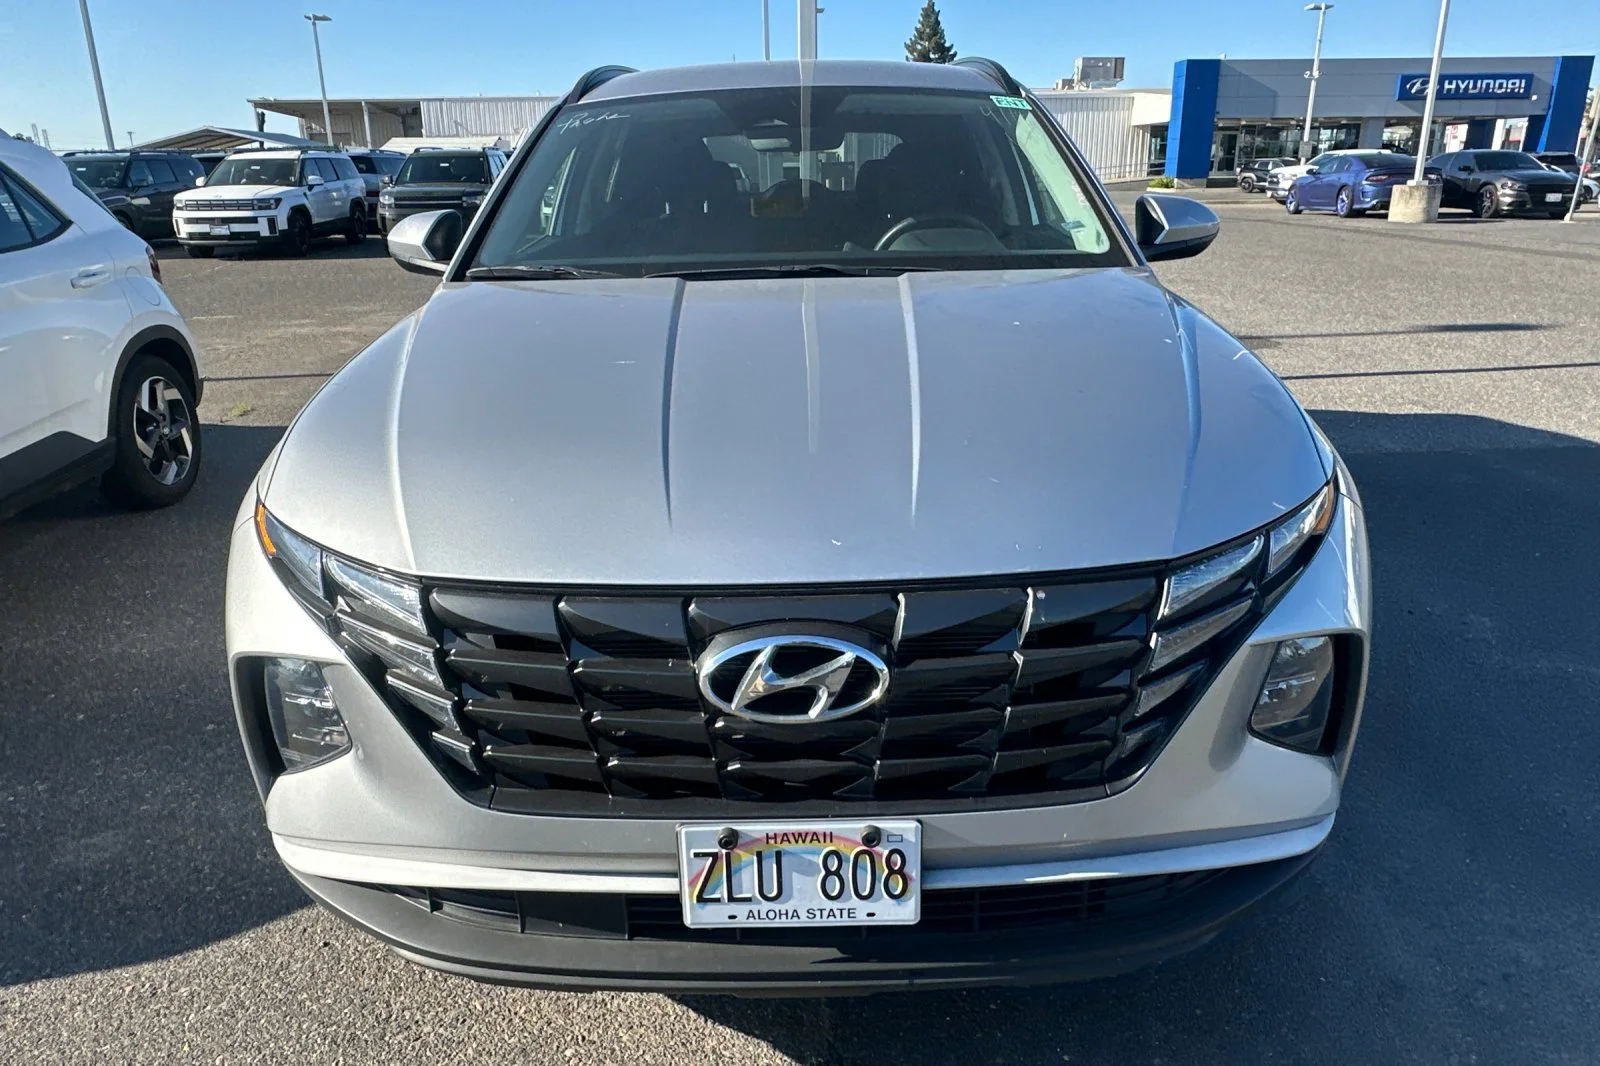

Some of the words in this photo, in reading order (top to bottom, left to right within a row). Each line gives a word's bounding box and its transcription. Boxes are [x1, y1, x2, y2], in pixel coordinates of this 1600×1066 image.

[1442, 79, 1527, 94] HYUNDAI
[765, 832, 833, 845] HAWAII
[693, 850, 782, 903] ZLU
[820, 848, 908, 901] 808
[745, 908, 801, 921] ALOHA
[806, 908, 857, 919] STATE
